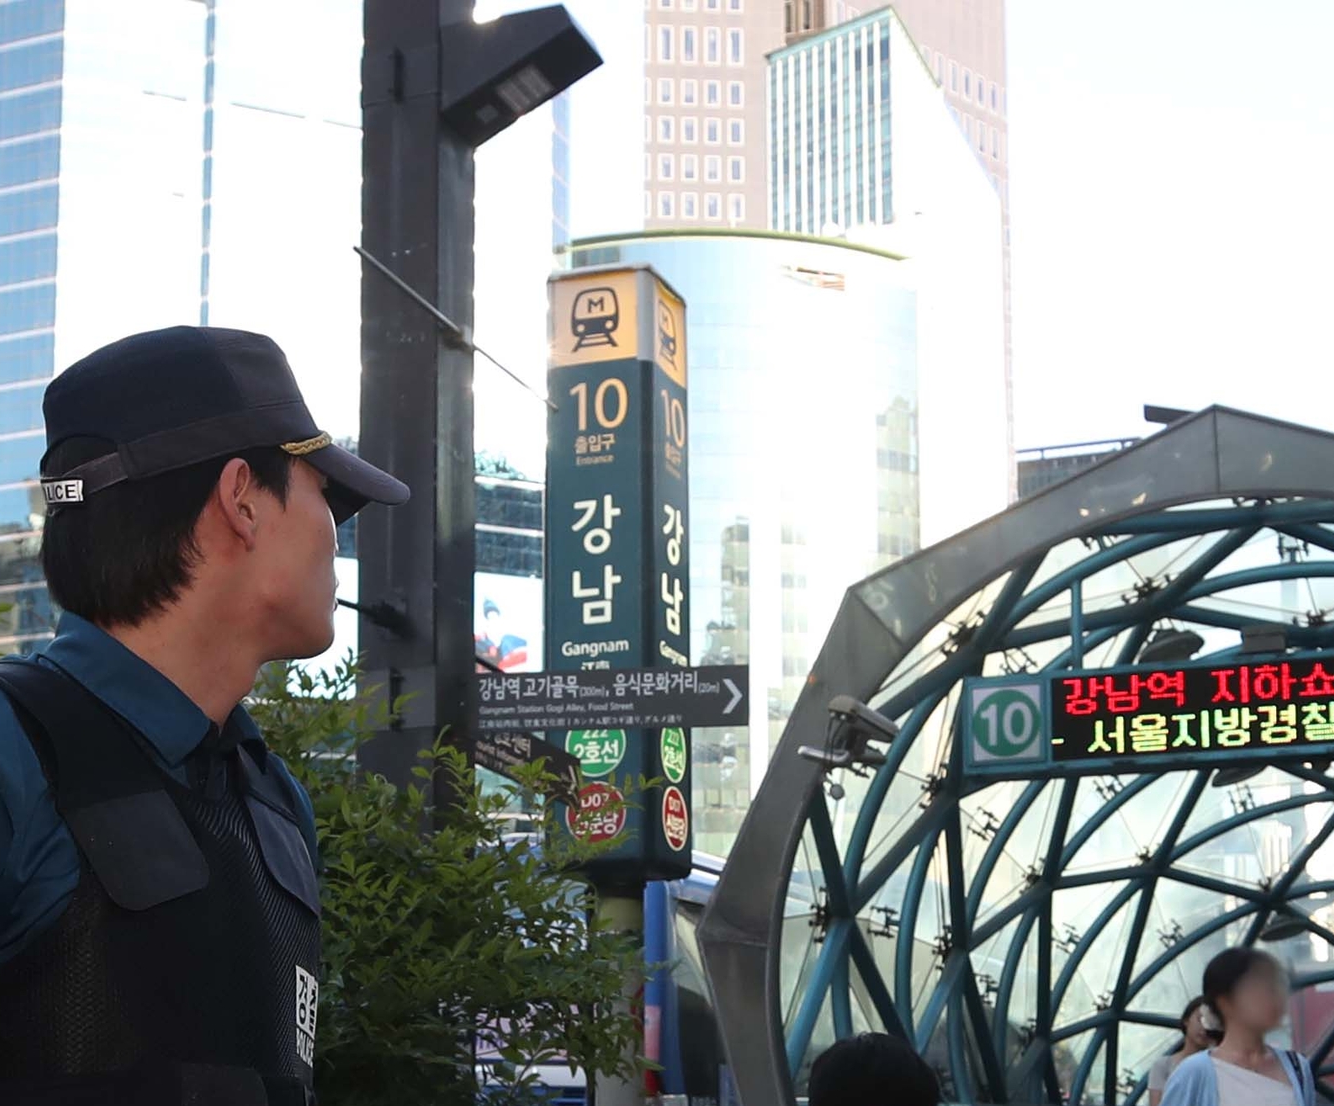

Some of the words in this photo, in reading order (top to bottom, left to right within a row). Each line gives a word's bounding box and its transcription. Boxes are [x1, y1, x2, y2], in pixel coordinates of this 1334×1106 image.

[569, 377, 628, 431] 10
[661, 389, 685, 448] 10
[575, 433, 615, 454] 출입구
[571, 494, 621, 625] 강남
[661, 504, 685, 636] 강남
[561, 639, 630, 658] Gangnam
[478, 678, 521, 702] 강남역
[478, 705, 516, 716] Gangnam
[517, 704, 545, 714] Station
[588, 702, 608, 711] Food
[610, 701, 635, 711] Street
[1063, 671, 1185, 715] 강남역
[979, 701, 1035, 747] 10
[573, 740, 619, 764] 2호선
